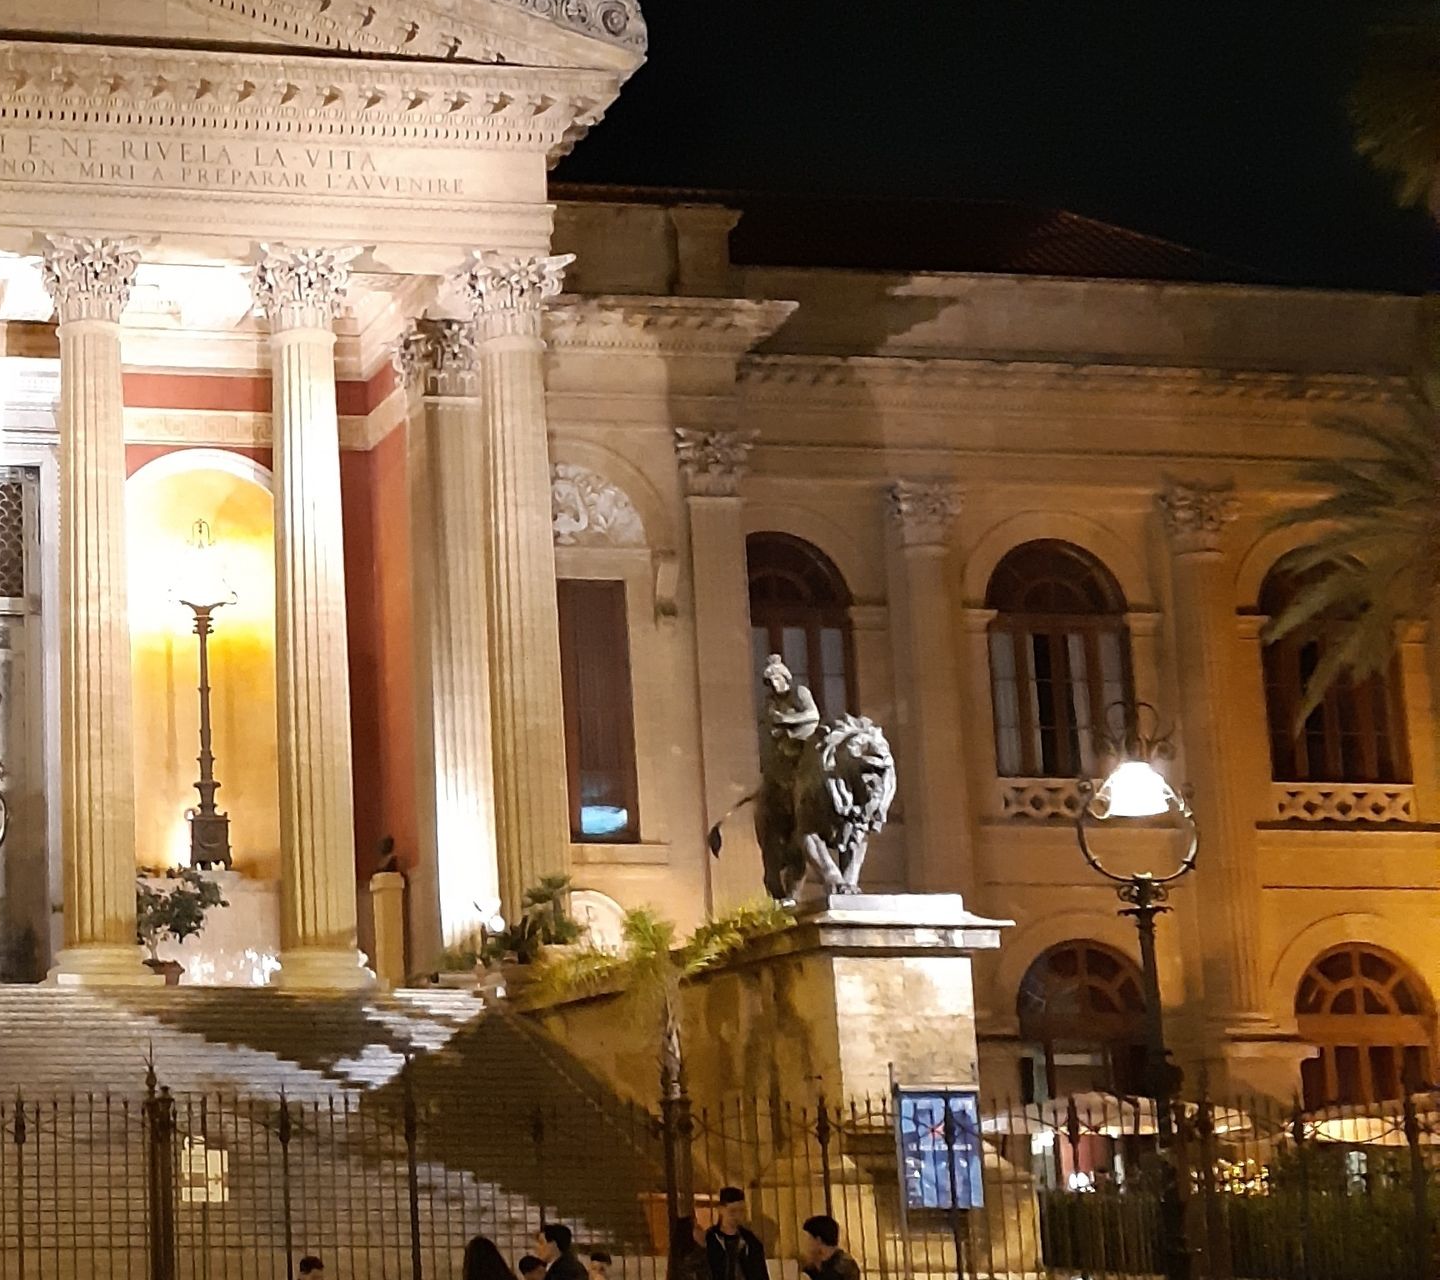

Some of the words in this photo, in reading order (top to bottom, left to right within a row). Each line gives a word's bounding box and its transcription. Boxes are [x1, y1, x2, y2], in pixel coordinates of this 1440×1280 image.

[27, 134, 42, 156] E
[61, 137, 100, 158] NE
[121, 140, 232, 165] RIVELA
[255, 145, 287, 168] LA
[305, 148, 377, 172] VITA
[3, 159, 56, 177] NON
[79, 161, 135, 181] MIRI
[152, 164, 165, 182] A
[182, 168, 308, 189] PREPARAR
[326, 173, 465, 195] L'AVVENIRE
